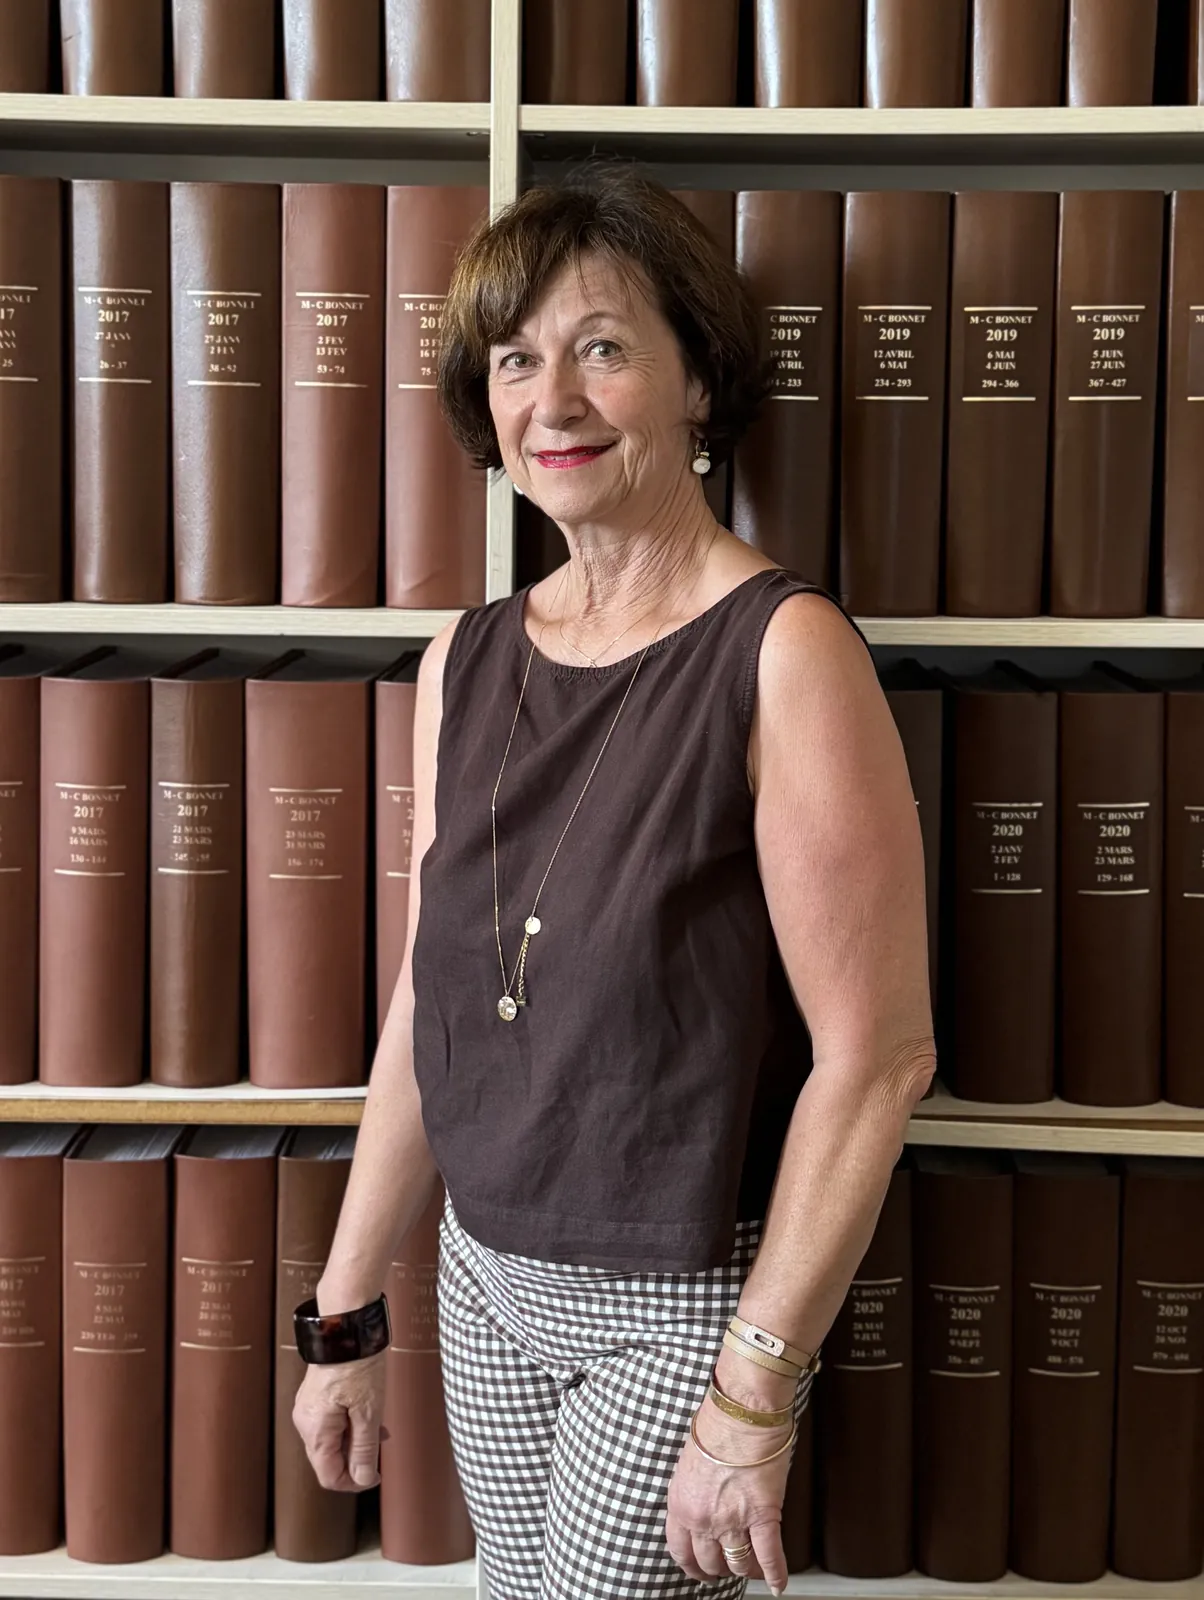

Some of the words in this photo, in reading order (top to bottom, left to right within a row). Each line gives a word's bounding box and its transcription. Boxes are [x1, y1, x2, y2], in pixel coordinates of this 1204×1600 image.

[216, 300, 255, 310] BONNET
[325, 301, 364, 311] BONNET
[0, 308, 14, 320] 17
[98, 309, 130, 322] 2017
[1102, 314, 1140, 323] BONNET
[208, 313, 240, 326] 2017
[316, 314, 348, 326] 2017
[779, 315, 817, 324] BONNET
[888, 315, 926, 323] BONNET
[995, 316, 1032, 324] BONNET
[770, 328, 801, 340] 2019
[879, 328, 911, 340] 2019
[986, 329, 1018, 342] 2019
[1093, 328, 1125, 340] 2019
[204, 335, 214, 344] 27
[318, 336, 323, 344] 2
[324, 336, 346, 345] FEV
[420, 338, 430, 347] 13
[316, 346, 326, 356] 13
[328, 347, 348, 356] FEV
[420, 350, 430, 358] 16
[780, 350, 800, 358] FEV
[874, 350, 883, 358] 12
[884, 350, 914, 358] AVRIL
[988, 351, 993, 360] 6
[995, 351, 1014, 360] MAI
[1092, 350, 1098, 358] 5
[1100, 350, 1124, 358] JUIN
[880, 361, 886, 369] 6
[888, 361, 907, 369] MAI
[986, 362, 991, 370] 4
[992, 362, 1016, 370] JUIN
[1090, 361, 1100, 369] 27
[1102, 361, 1126, 369] JUIN
[82, 793, 120, 802] BONNET
[186, 792, 223, 800] BONNET
[298, 797, 336, 806] BONNET
[74, 806, 104, 818] 2017
[178, 804, 208, 817] 2017
[291, 810, 320, 822] 2017
[1000, 812, 1038, 820] BONNET
[1108, 812, 1144, 820] BONNET
[992, 824, 1023, 836] 2020
[1099, 824, 1130, 837] 2020
[298, 831, 326, 840] MARS
[298, 841, 326, 850] MARS
[992, 844, 996, 853] 2
[998, 845, 1023, 854] JANV
[1097, 846, 1102, 854] 2
[1104, 846, 1133, 854] MARS
[994, 856, 1000, 864] 2
[1001, 856, 1020, 864] FEV
[1094, 856, 1105, 864] 23
[1107, 856, 1135, 865] MARS
[0, 1278, 24, 1291] 017
[202, 1281, 231, 1293] 2017
[94, 1284, 125, 1297] 2017
[861, 1287, 898, 1297] BONNET
[958, 1295, 996, 1304] BONNET
[1060, 1294, 1096, 1304] BONNET
[854, 1302, 884, 1314] 2020
[1158, 1304, 1188, 1317] 2020
[950, 1308, 981, 1320] 2020
[1050, 1308, 1082, 1320] 2020
